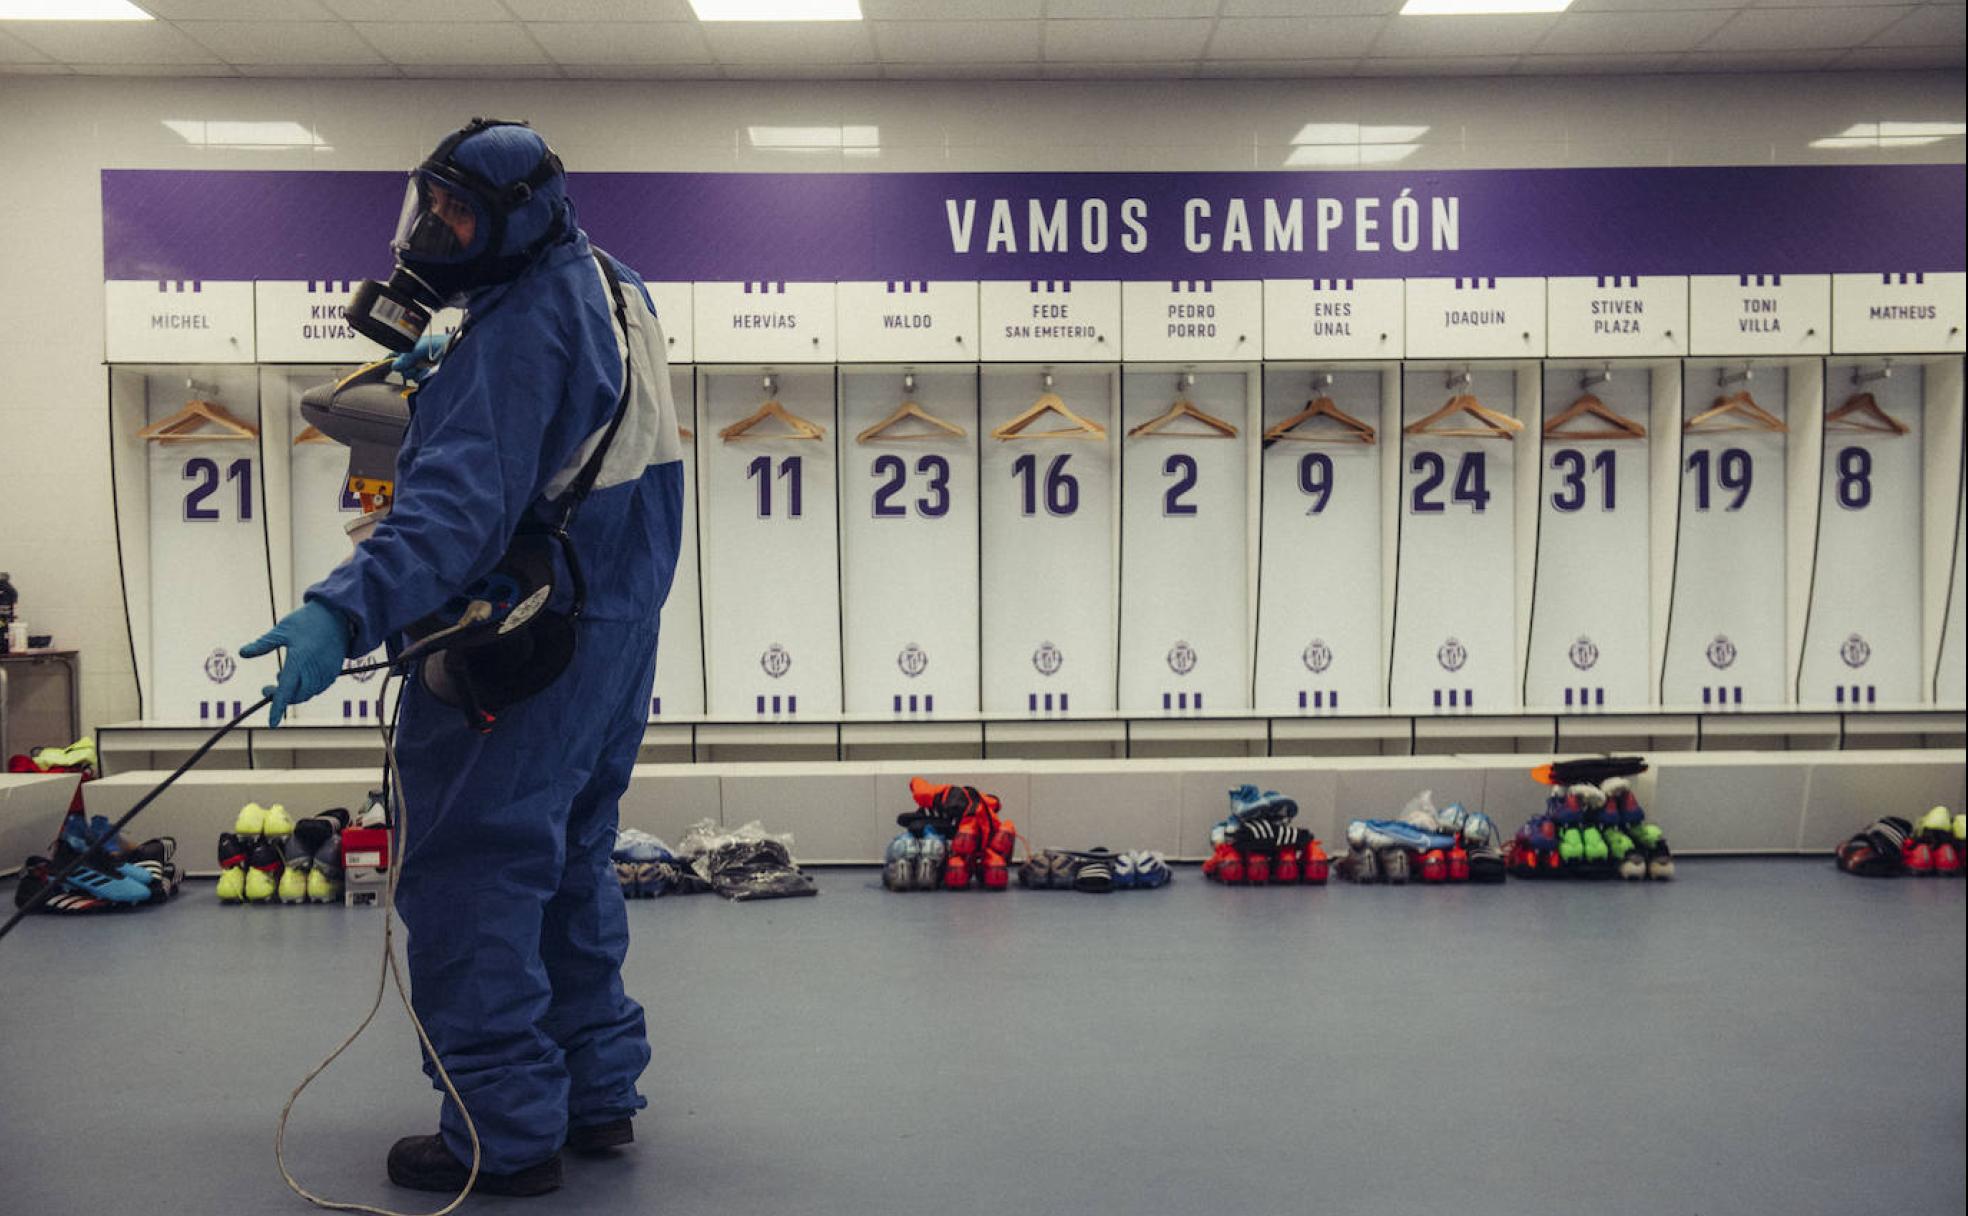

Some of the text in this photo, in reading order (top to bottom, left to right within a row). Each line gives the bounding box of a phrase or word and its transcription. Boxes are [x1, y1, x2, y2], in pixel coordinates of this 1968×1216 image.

[946, 188, 1459, 253] VAMOS CAMPEÓN
[1033, 305, 1068, 318] FEDE
[1169, 304, 1214, 318] PEDRO
[1315, 303, 1350, 316] ENES
[1592, 301, 1642, 314] STIVEN
[1744, 300, 1776, 313] TONI
[1870, 306, 1935, 319] MATHEUS
[884, 314, 931, 328] WALDO
[1595, 320, 1640, 333] PLAZA
[1739, 318, 1780, 332] VILLA
[304, 325, 355, 339] OLIVAS
[1006, 326, 1095, 337] SAN EMETERIO
[1168, 324, 1215, 337] PORRO
[1012, 454, 1078, 515] 16
[1163, 454, 1197, 514] 2
[1298, 453, 1333, 512] 9
[1411, 452, 1490, 511] 24
[1551, 449, 1615, 511] 31
[1685, 448, 1753, 510] 19
[1838, 447, 1871, 508] 8
[183, 458, 251, 519] 21
[747, 456, 802, 516] 11
[872, 455, 949, 518] 23
